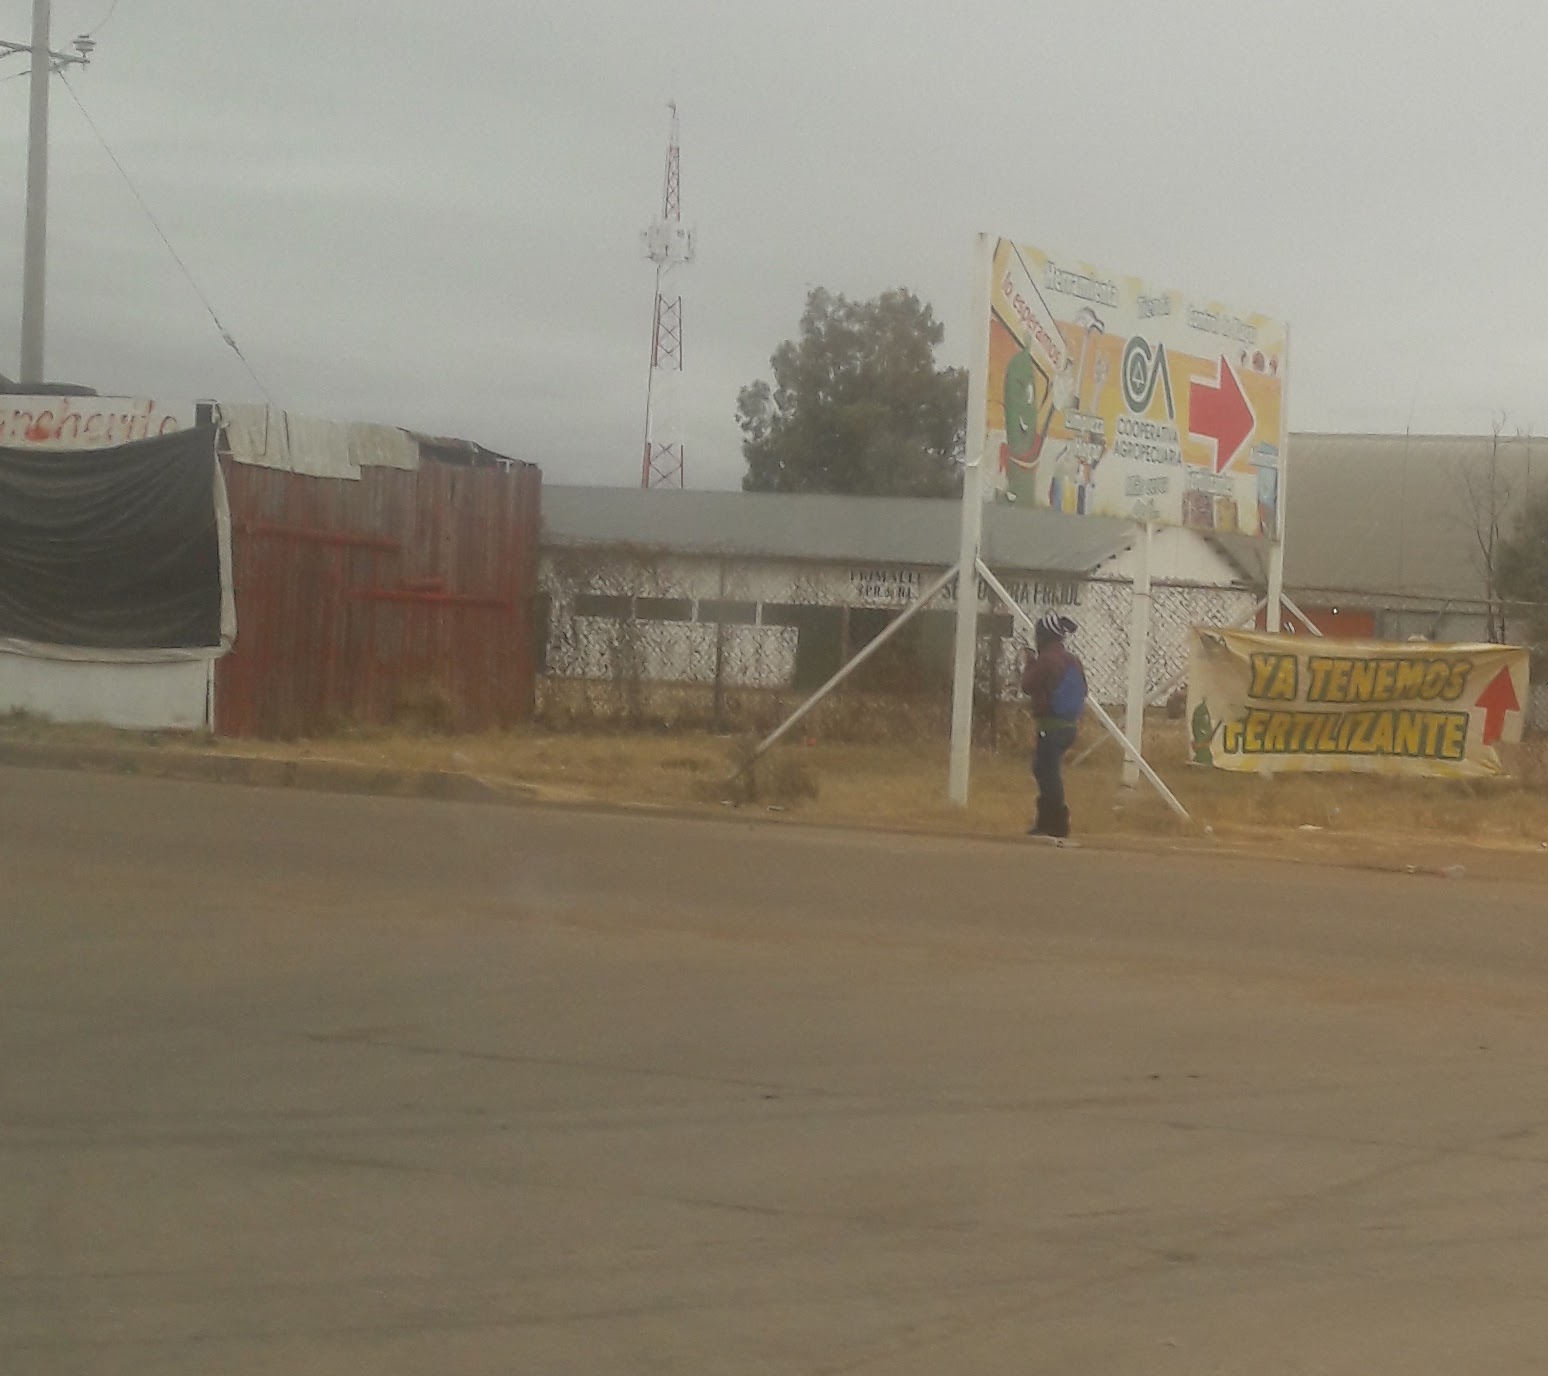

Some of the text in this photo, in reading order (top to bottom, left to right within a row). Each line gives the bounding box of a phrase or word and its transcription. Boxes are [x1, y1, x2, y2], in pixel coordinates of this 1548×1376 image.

[1248, 653, 1474, 703] YA TENEMOS
[1223, 707, 1470, 761] FERTILIZANTE
